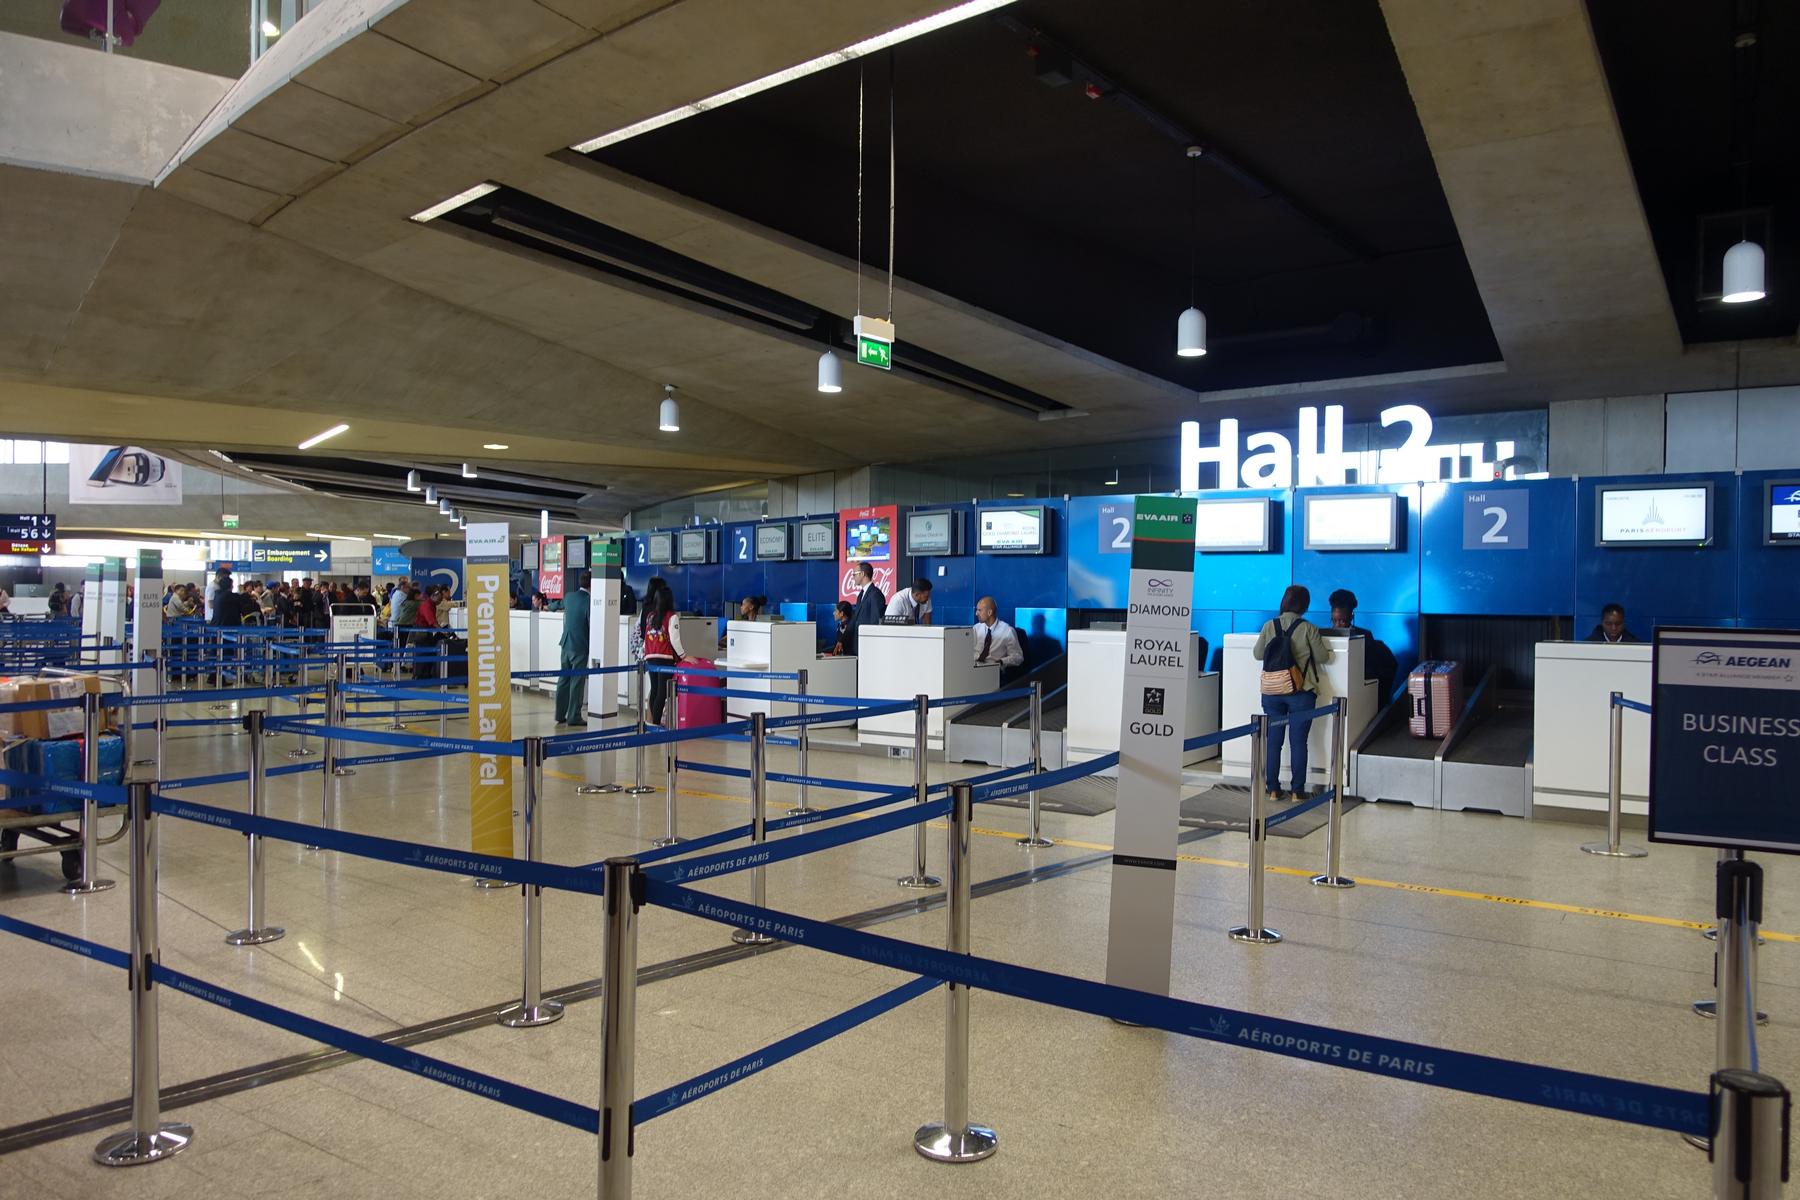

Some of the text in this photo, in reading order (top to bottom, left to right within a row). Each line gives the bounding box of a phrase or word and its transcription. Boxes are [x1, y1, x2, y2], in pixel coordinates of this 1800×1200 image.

[1180, 405, 1343, 491] Hall
[1378, 404, 1436, 485] 2
[1468, 494, 1486, 503] Hall
[31, 516, 37, 526] 1
[1481, 507, 1509, 543] 2
[21, 528, 28, 538] 5
[30, 528, 38, 538] 6
[760, 536, 783, 544] ECONOMY
[808, 532, 826, 542] ELITE
[1112, 517, 1131, 548] 2
[639, 544, 644, 563] 2
[740, 537, 747, 559] 2
[1130, 604, 1190, 617] DIAMOND
[476, 575, 502, 697] Premium
[1134, 638, 1182, 652] ROYAL
[1130, 654, 1184, 668] LAUREL
[1725, 656, 1791, 668] AEGEAN
[1129, 722, 1174, 737] GOLD
[1683, 713, 1800, 737] BUSINESS
[576, 743, 604, 752] AÉROPORTS
[1703, 744, 1777, 767] CLASS
[990, 788, 1012, 797] AÉROPORTS
[208, 814, 215, 822] DE
[216, 816, 232, 826] PARIS
[424, 855, 502, 874] AÉROPORTS DE PARIS
[688, 852, 770, 878] AÉROPORTS DE PARIS
[1484, 896, 1529, 904] STOP
[1580, 908, 1629, 917] STOP
[698, 904, 804, 938] AÉROPORTS DE PARIS
[208, 991, 215, 1000] DE
[216, 994, 232, 1006] PARIS
[1238, 1026, 1436, 1076] AÉROPORTS DE PARIS
[423, 1065, 501, 1097] AÉROPORTS DE PARIS
[681, 1058, 764, 1101] AÉROPORTS DE PARIS
